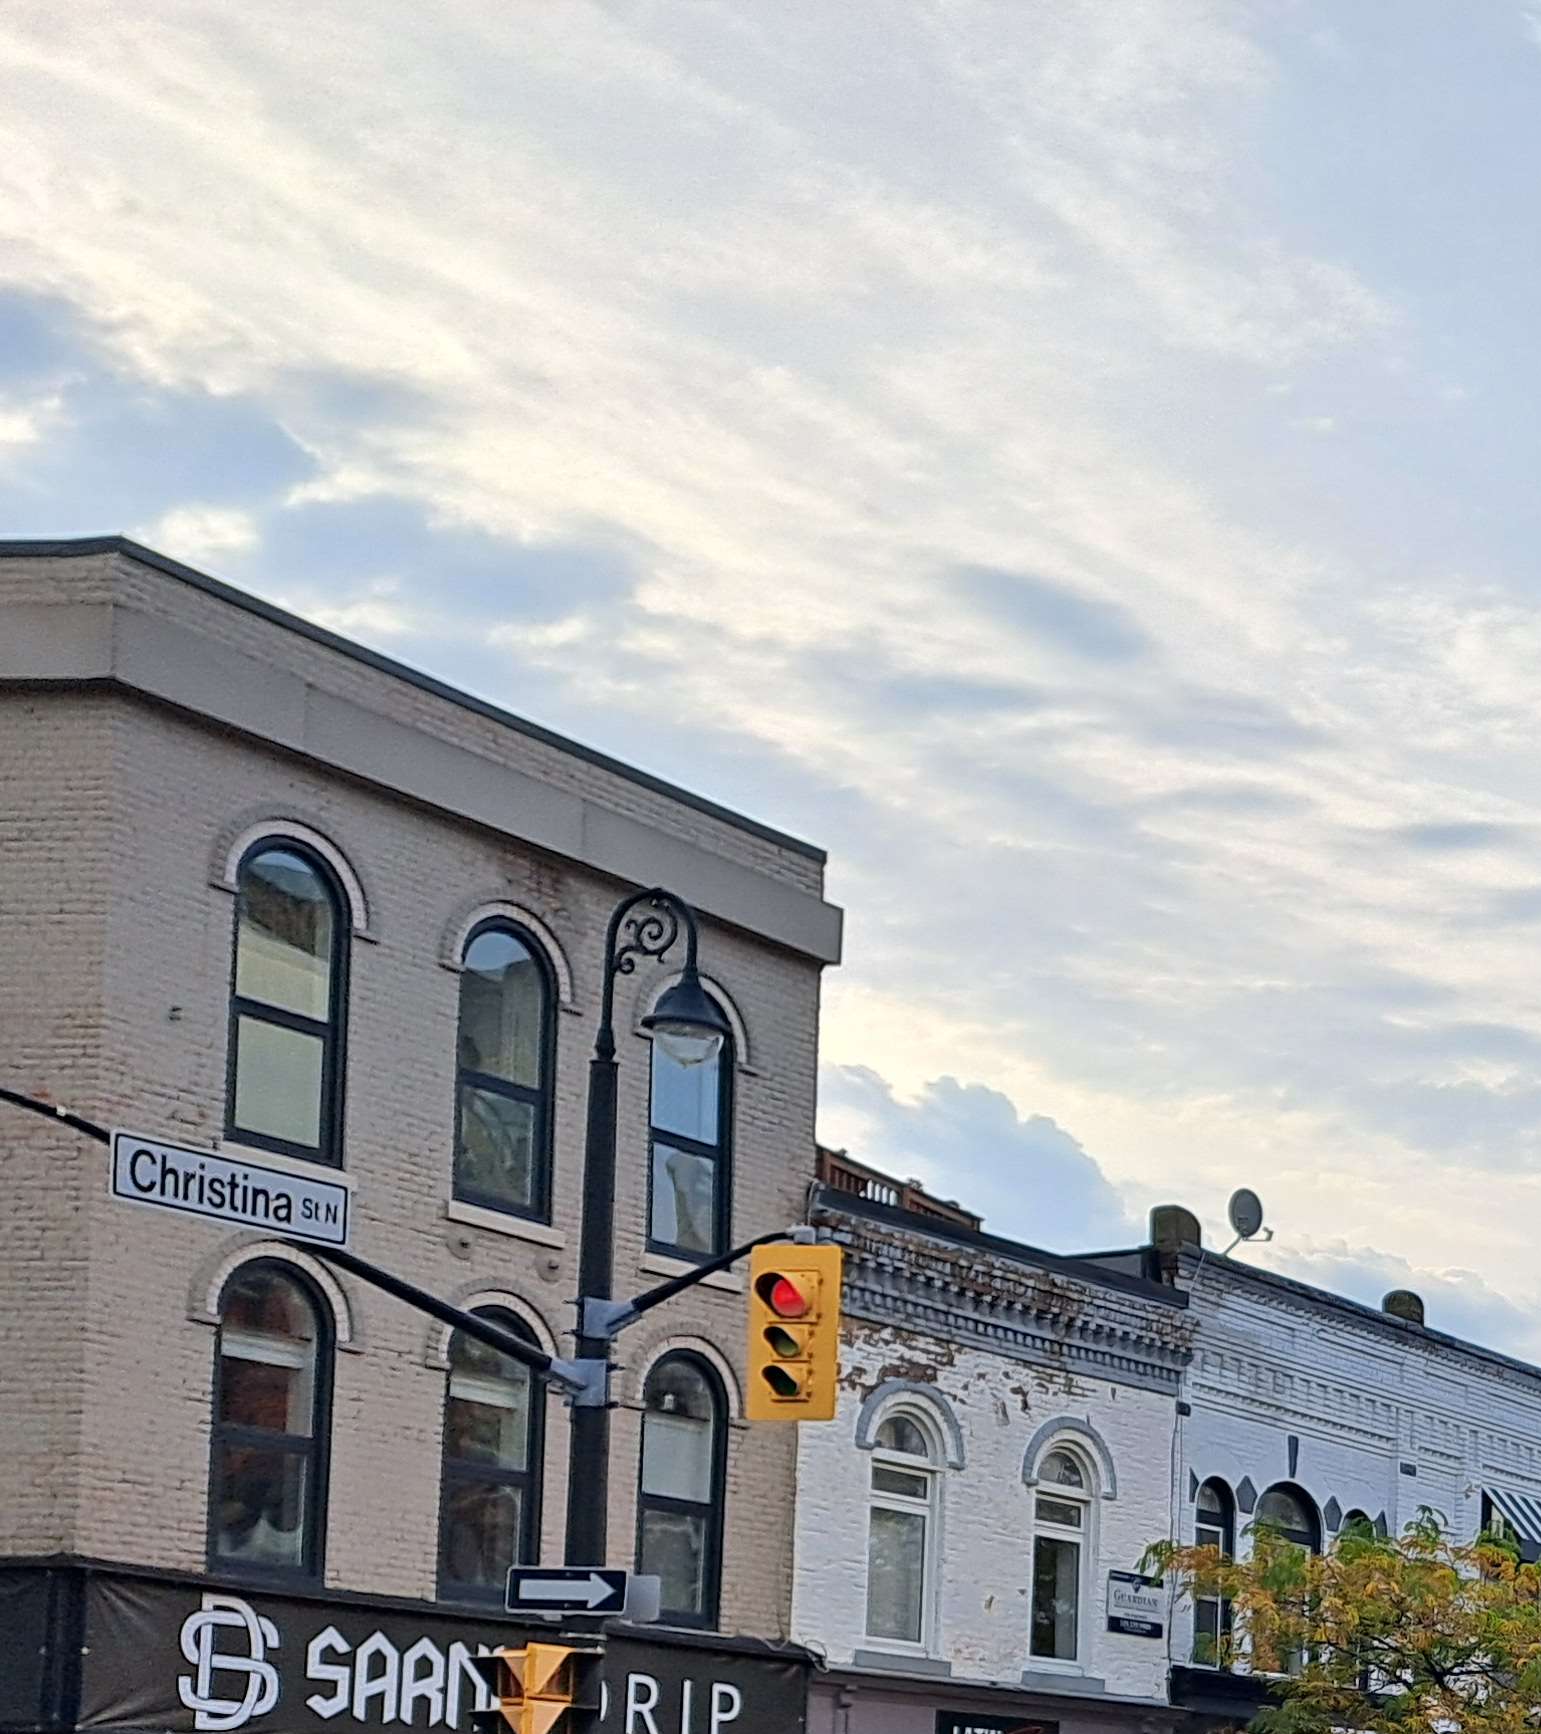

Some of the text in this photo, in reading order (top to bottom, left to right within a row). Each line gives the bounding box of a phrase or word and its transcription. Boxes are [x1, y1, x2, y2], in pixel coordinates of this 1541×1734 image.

[129, 1148, 339, 1225] Christina St N
[304, 1624, 506, 1732] SARN
